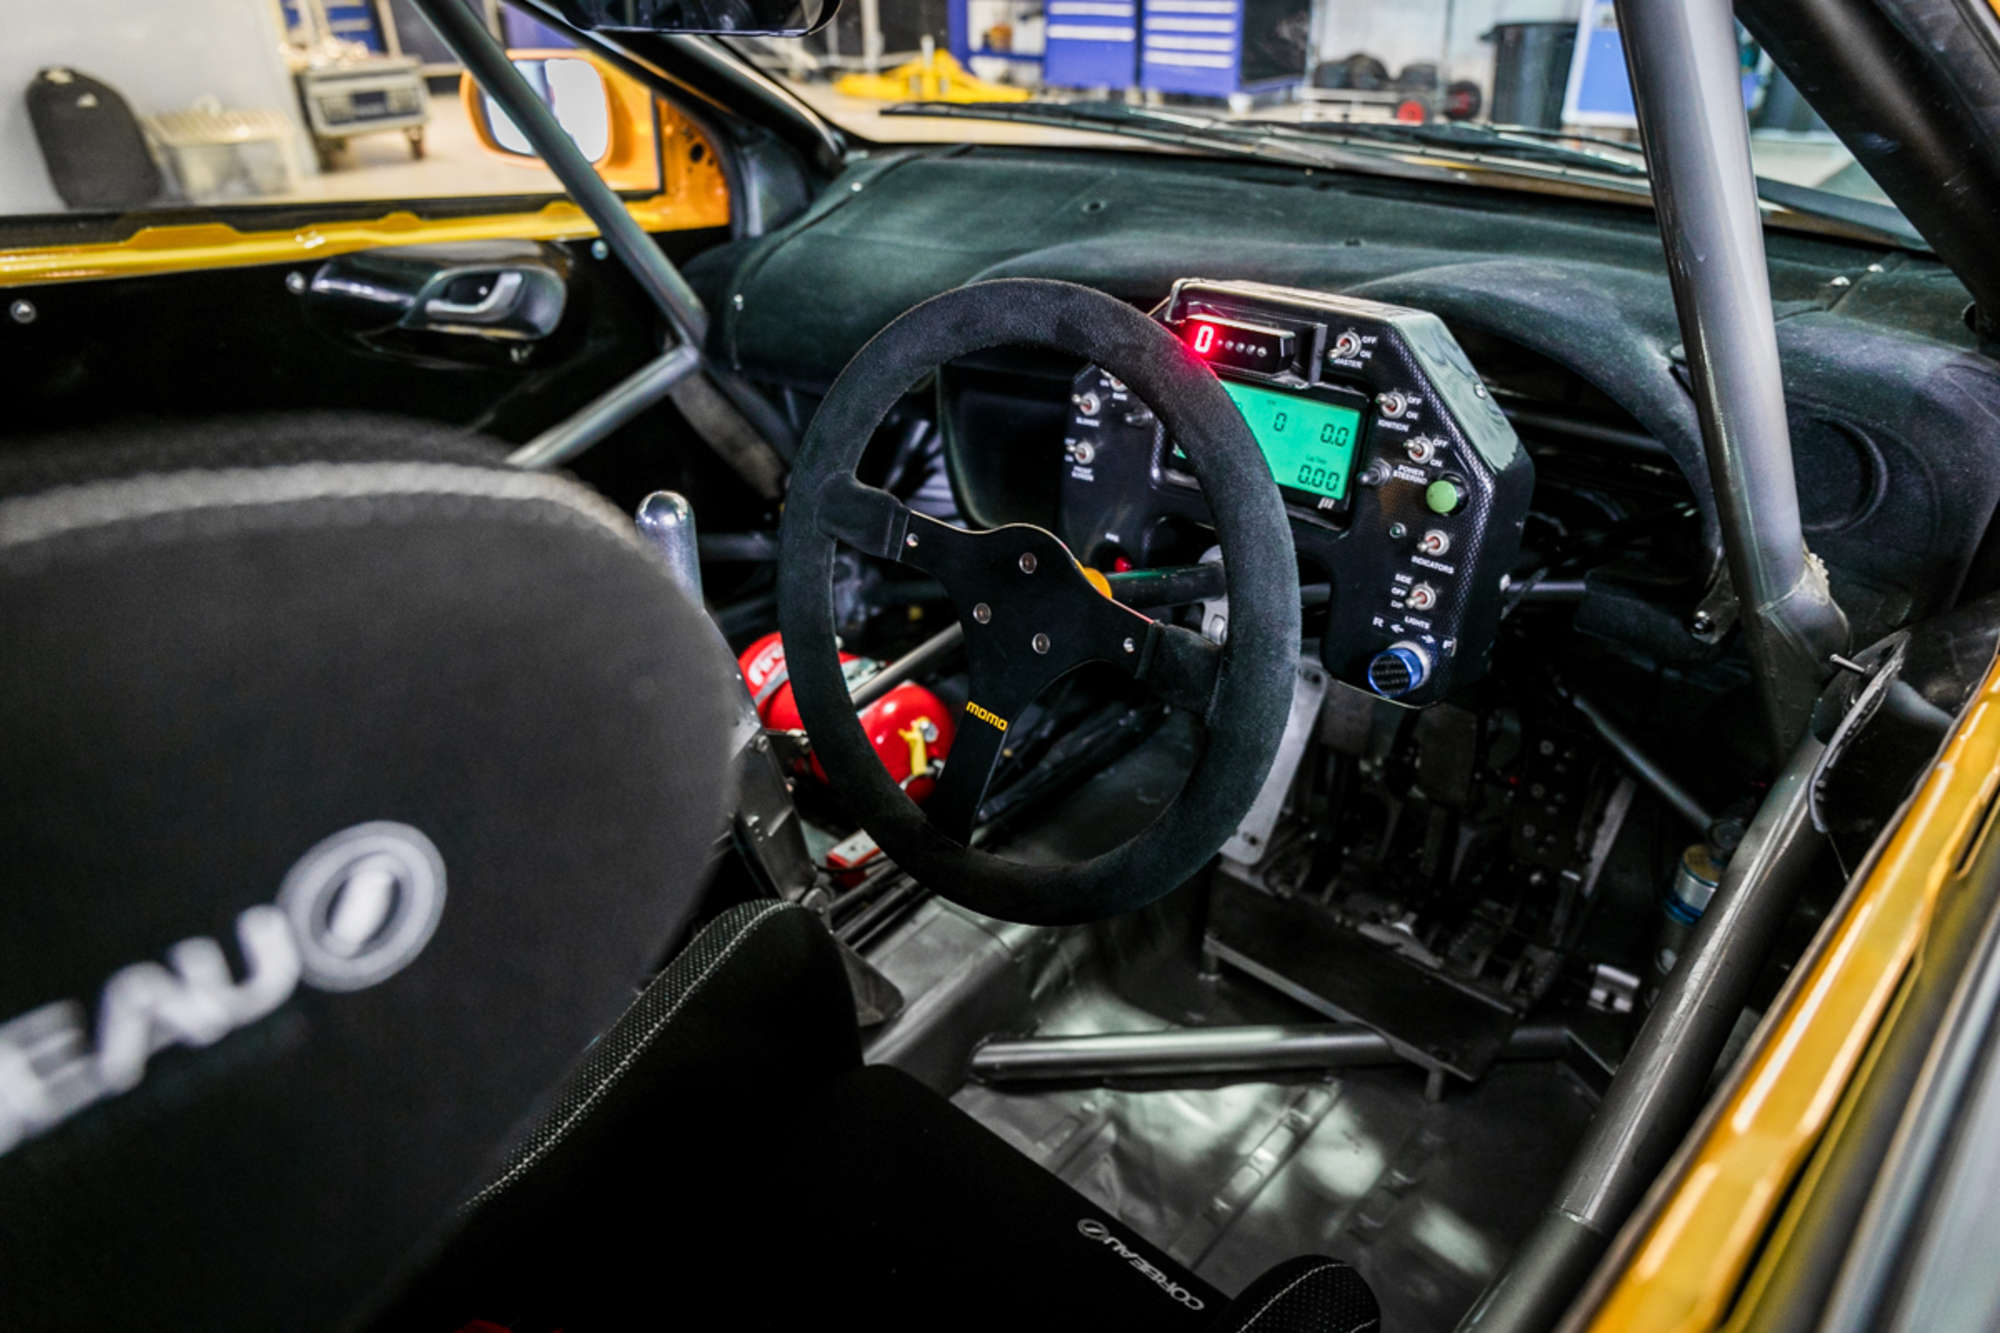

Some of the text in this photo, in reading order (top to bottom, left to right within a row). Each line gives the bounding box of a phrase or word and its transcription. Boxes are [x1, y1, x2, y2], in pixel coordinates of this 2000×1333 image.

[1194, 325, 1214, 353] 0
[1362, 336, 1376, 344] OFF
[1360, 350, 1372, 358] ON
[1407, 396, 1422, 405] OFF
[1406, 411, 1418, 419] ON
[1273, 412, 1287, 432] 0
[1378, 419, 1409, 432] IGNITION
[1320, 423, 1350, 447] 0.0
[1433, 439, 1449, 448] OFF
[1430, 459, 1443, 468] ON
[1393, 470, 1427, 484] STEERING
[1398, 464, 1425, 477] POWER
[1298, 464, 1340, 492] 0.00
[1411, 556, 1454, 574] INDICATORS
[1395, 574, 1412, 584] SIDE
[1391, 587, 1406, 597] OFF
[1404, 616, 1430, 629] LIGHTS
[1372, 616, 1453, 649] R F
[966, 700, 1008, 732] momo
[1103, 1236, 1205, 1311] CORBEAU
